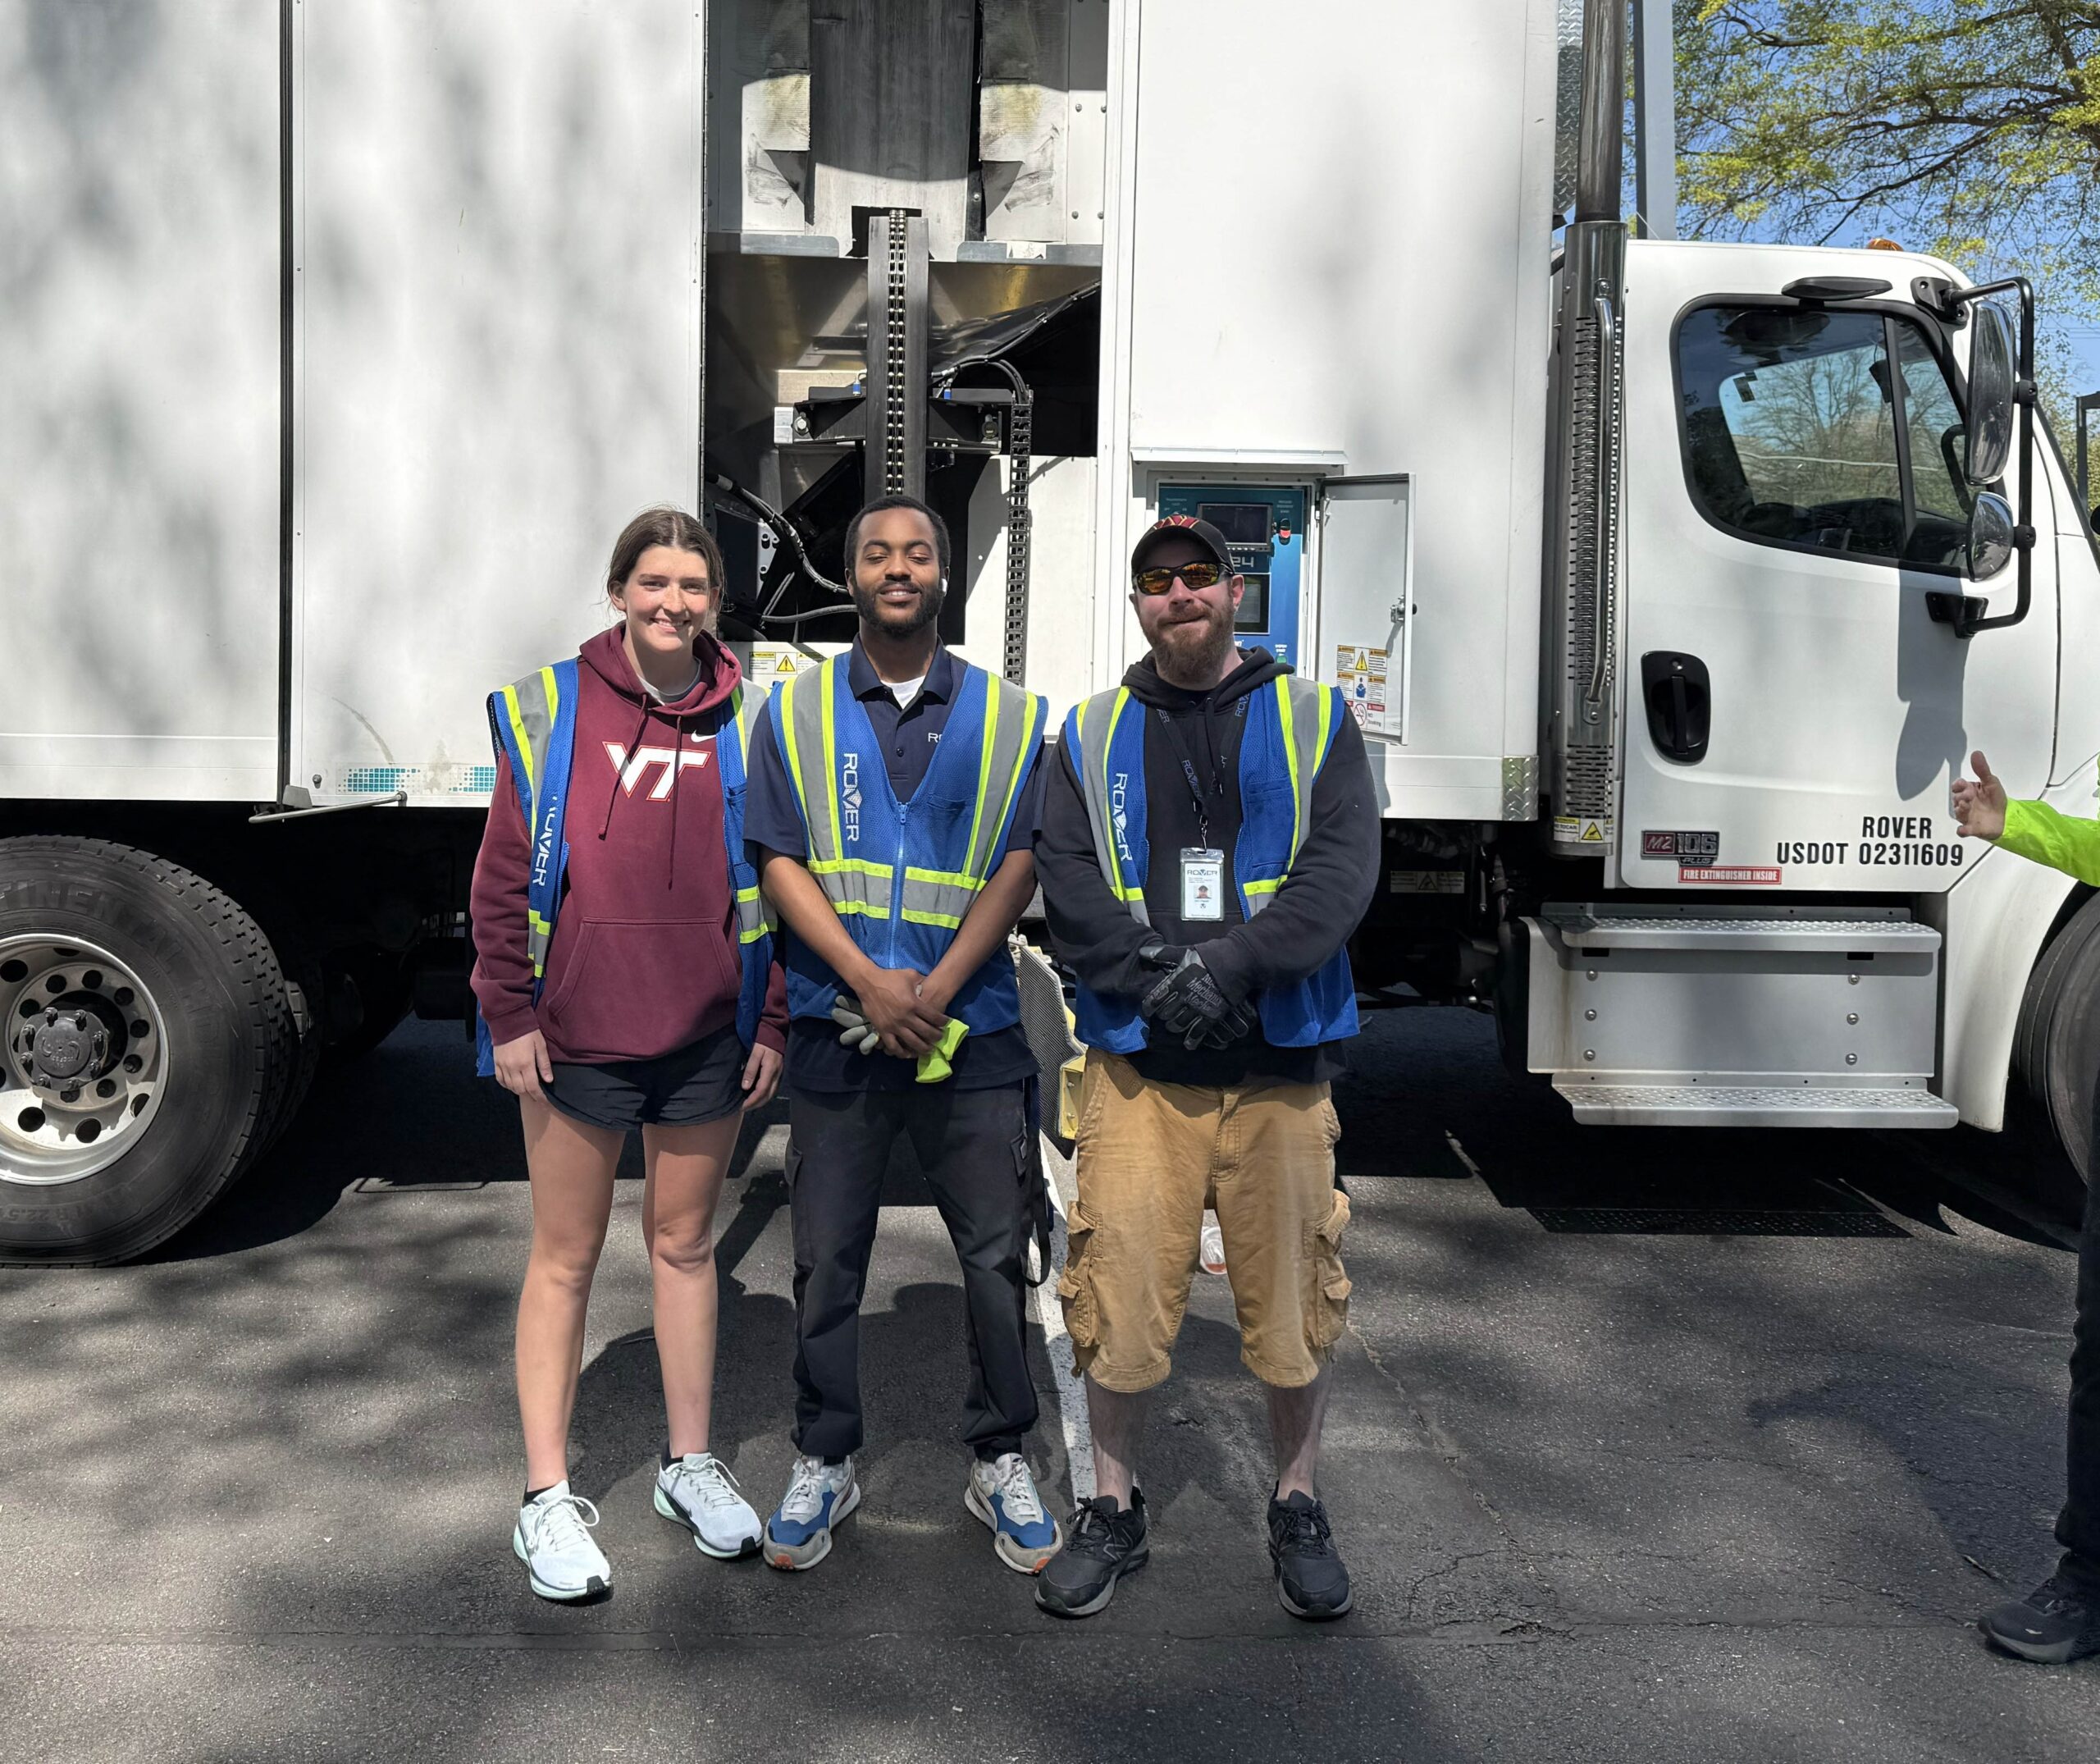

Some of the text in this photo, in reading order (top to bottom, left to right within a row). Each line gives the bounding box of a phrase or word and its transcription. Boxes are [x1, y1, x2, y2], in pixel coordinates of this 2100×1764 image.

[601, 741, 712, 802] VT
[842, 752, 863, 842] ROVER
[1112, 773, 1133, 862] ROVER
[532, 796, 558, 887] OVER
[1646, 833, 1718, 855] M2 106
[1861, 816, 1932, 839] ROVER
[1683, 869, 1778, 881] FIRE EXTINGUISHER INSIDE
[1776, 842, 1964, 866] USDOT 02311609
